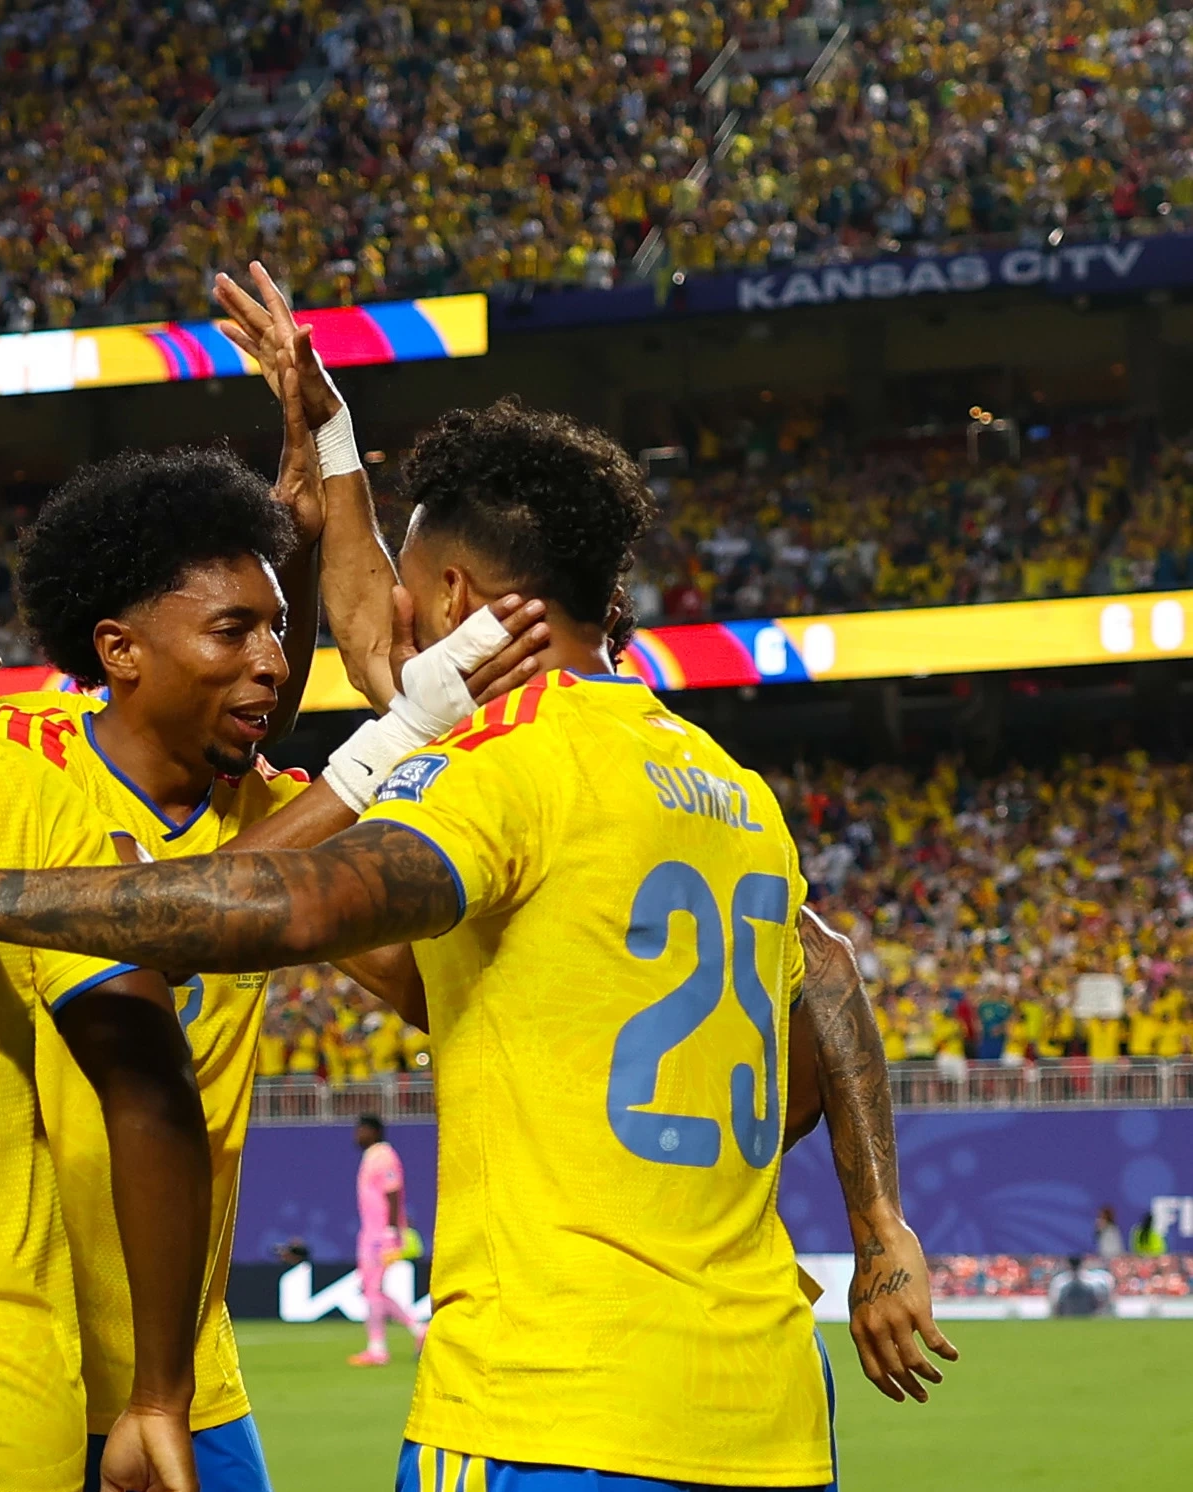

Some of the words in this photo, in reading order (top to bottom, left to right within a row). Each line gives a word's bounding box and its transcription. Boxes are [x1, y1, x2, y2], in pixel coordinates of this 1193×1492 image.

[737, 255, 991, 311] KANSAS
[1001, 242, 1146, 285] CITY
[607, 860, 789, 1169] 25
